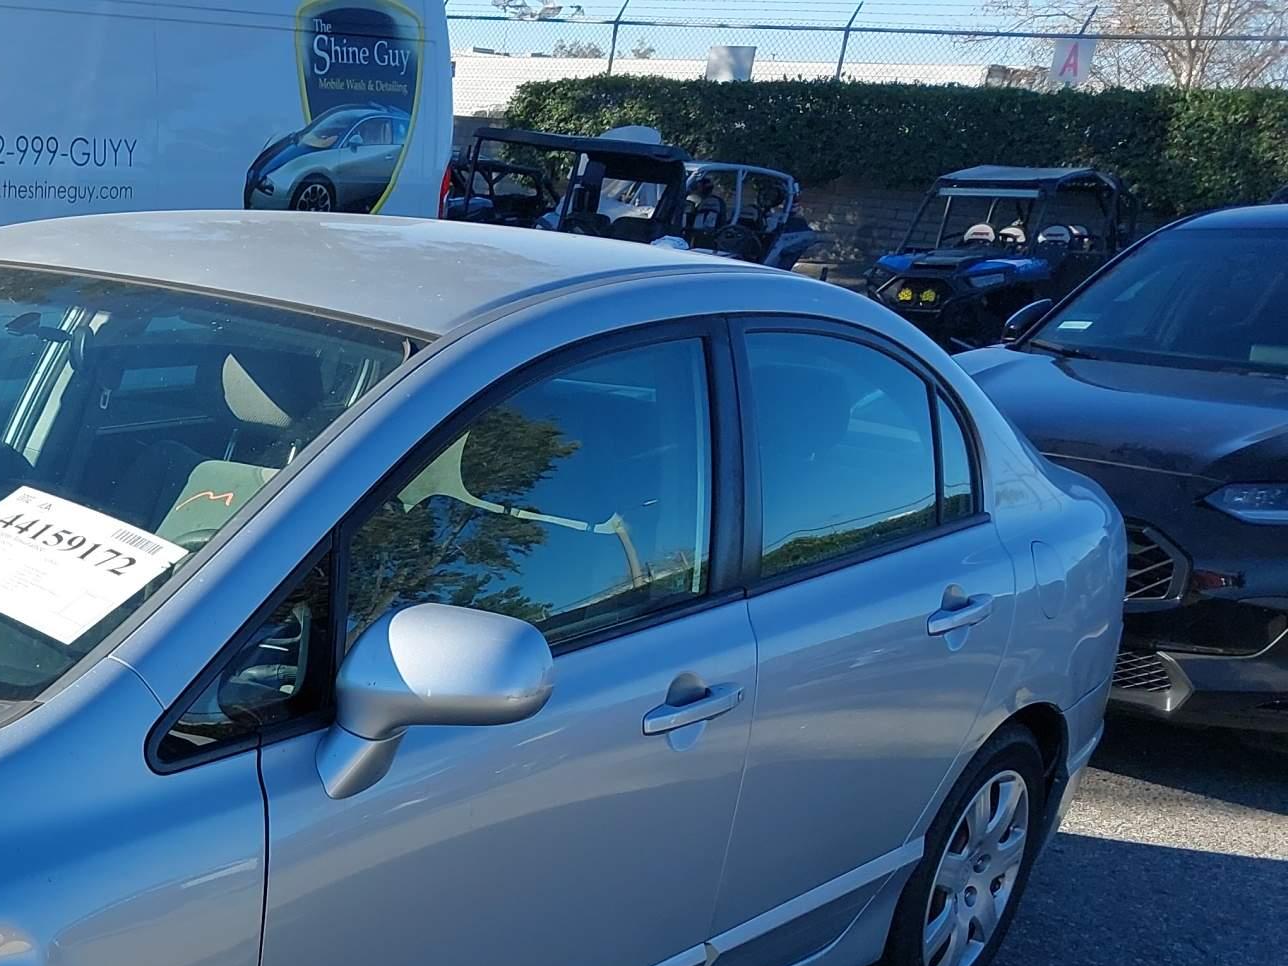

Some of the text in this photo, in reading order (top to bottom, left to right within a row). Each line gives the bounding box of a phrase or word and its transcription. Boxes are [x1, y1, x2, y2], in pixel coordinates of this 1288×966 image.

[313, 18, 332, 33] The
[313, 34, 410, 76] Shine Guy
[1059, 42, 1079, 77] A
[318, 78, 409, 97] Mobile Wash & Detailing
[0, 512, 138, 577] 44159172
